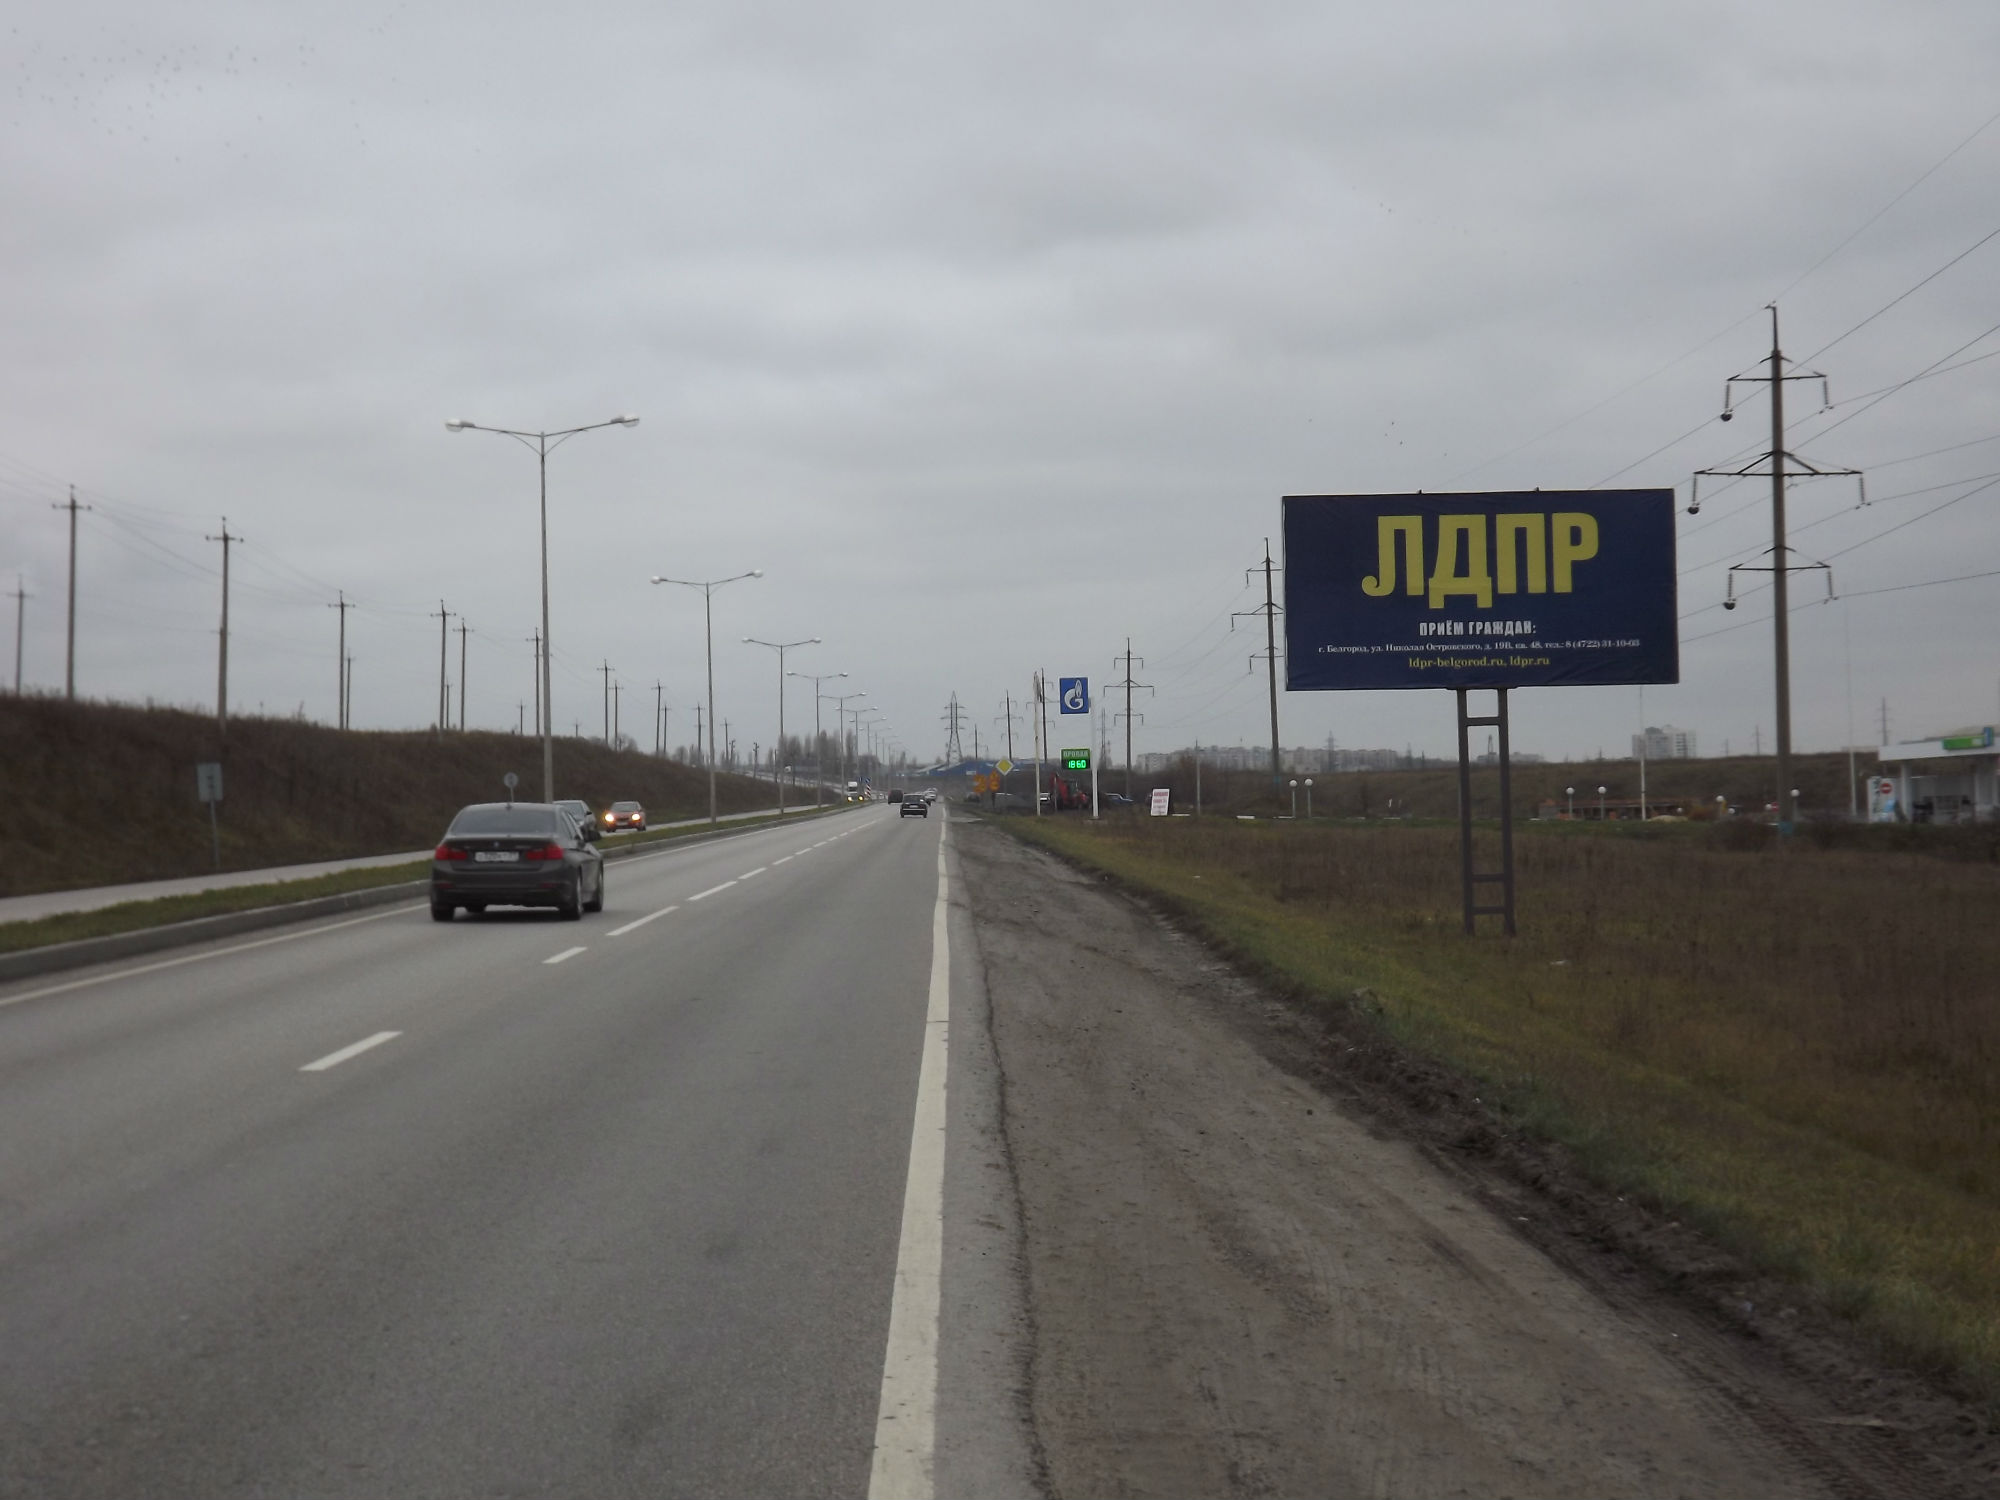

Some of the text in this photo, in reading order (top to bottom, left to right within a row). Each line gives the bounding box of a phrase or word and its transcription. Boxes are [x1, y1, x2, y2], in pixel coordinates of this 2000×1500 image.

[1361, 512, 1599, 609] ЛДПР
[1419, 620, 1537, 637] ПРИЁМ ГРАЖДАН:
[1385, 643, 1425, 652] Николая
[1510, 655, 1551, 668] ldpr.ru
